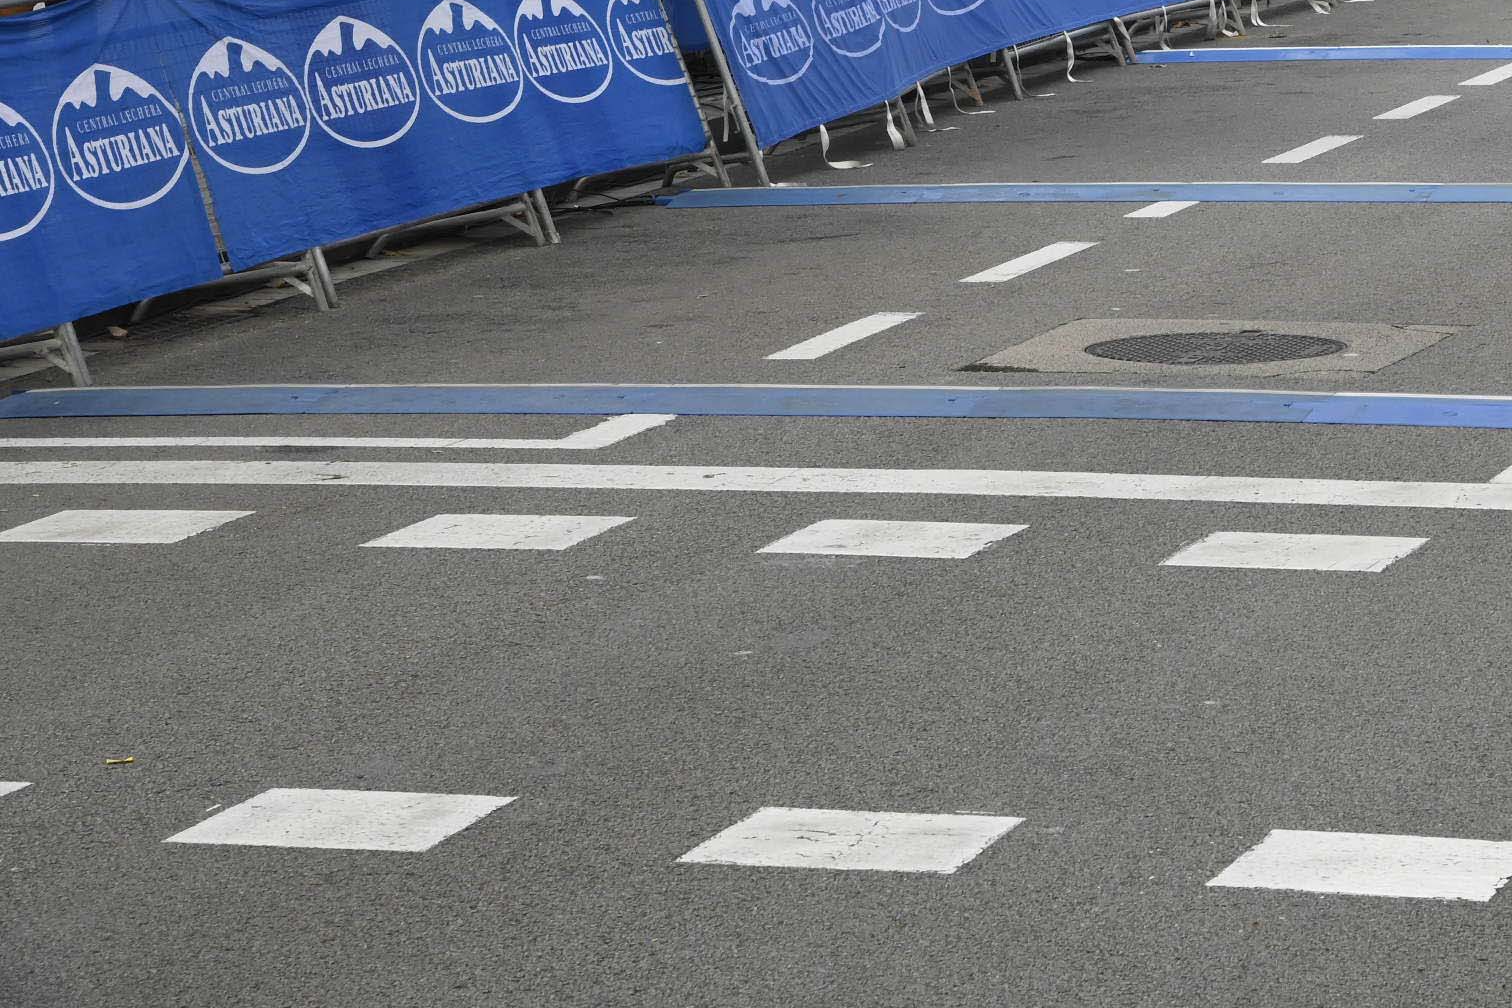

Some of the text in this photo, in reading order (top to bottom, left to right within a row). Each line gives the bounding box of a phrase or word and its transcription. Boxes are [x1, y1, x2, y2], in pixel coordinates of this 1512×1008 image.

[531, 21, 592, 40] CENTRAL LECHERA
[617, 18, 677, 61] ASTUR
[625, 11, 658, 25] CENTRAL
[325, 53, 400, 79] CENTRAL LECHERA
[428, 48, 519, 96] ASTURIANA
[523, 33, 608, 78] ASTURIANA
[211, 76, 290, 103] CENTRAL LECHERA
[315, 71, 416, 122] ASTURIANA
[76, 103, 163, 134] CENTRAL LECHERA
[201, 95, 305, 148] ASTURIANA
[65, 123, 181, 182] ASTURIANA
